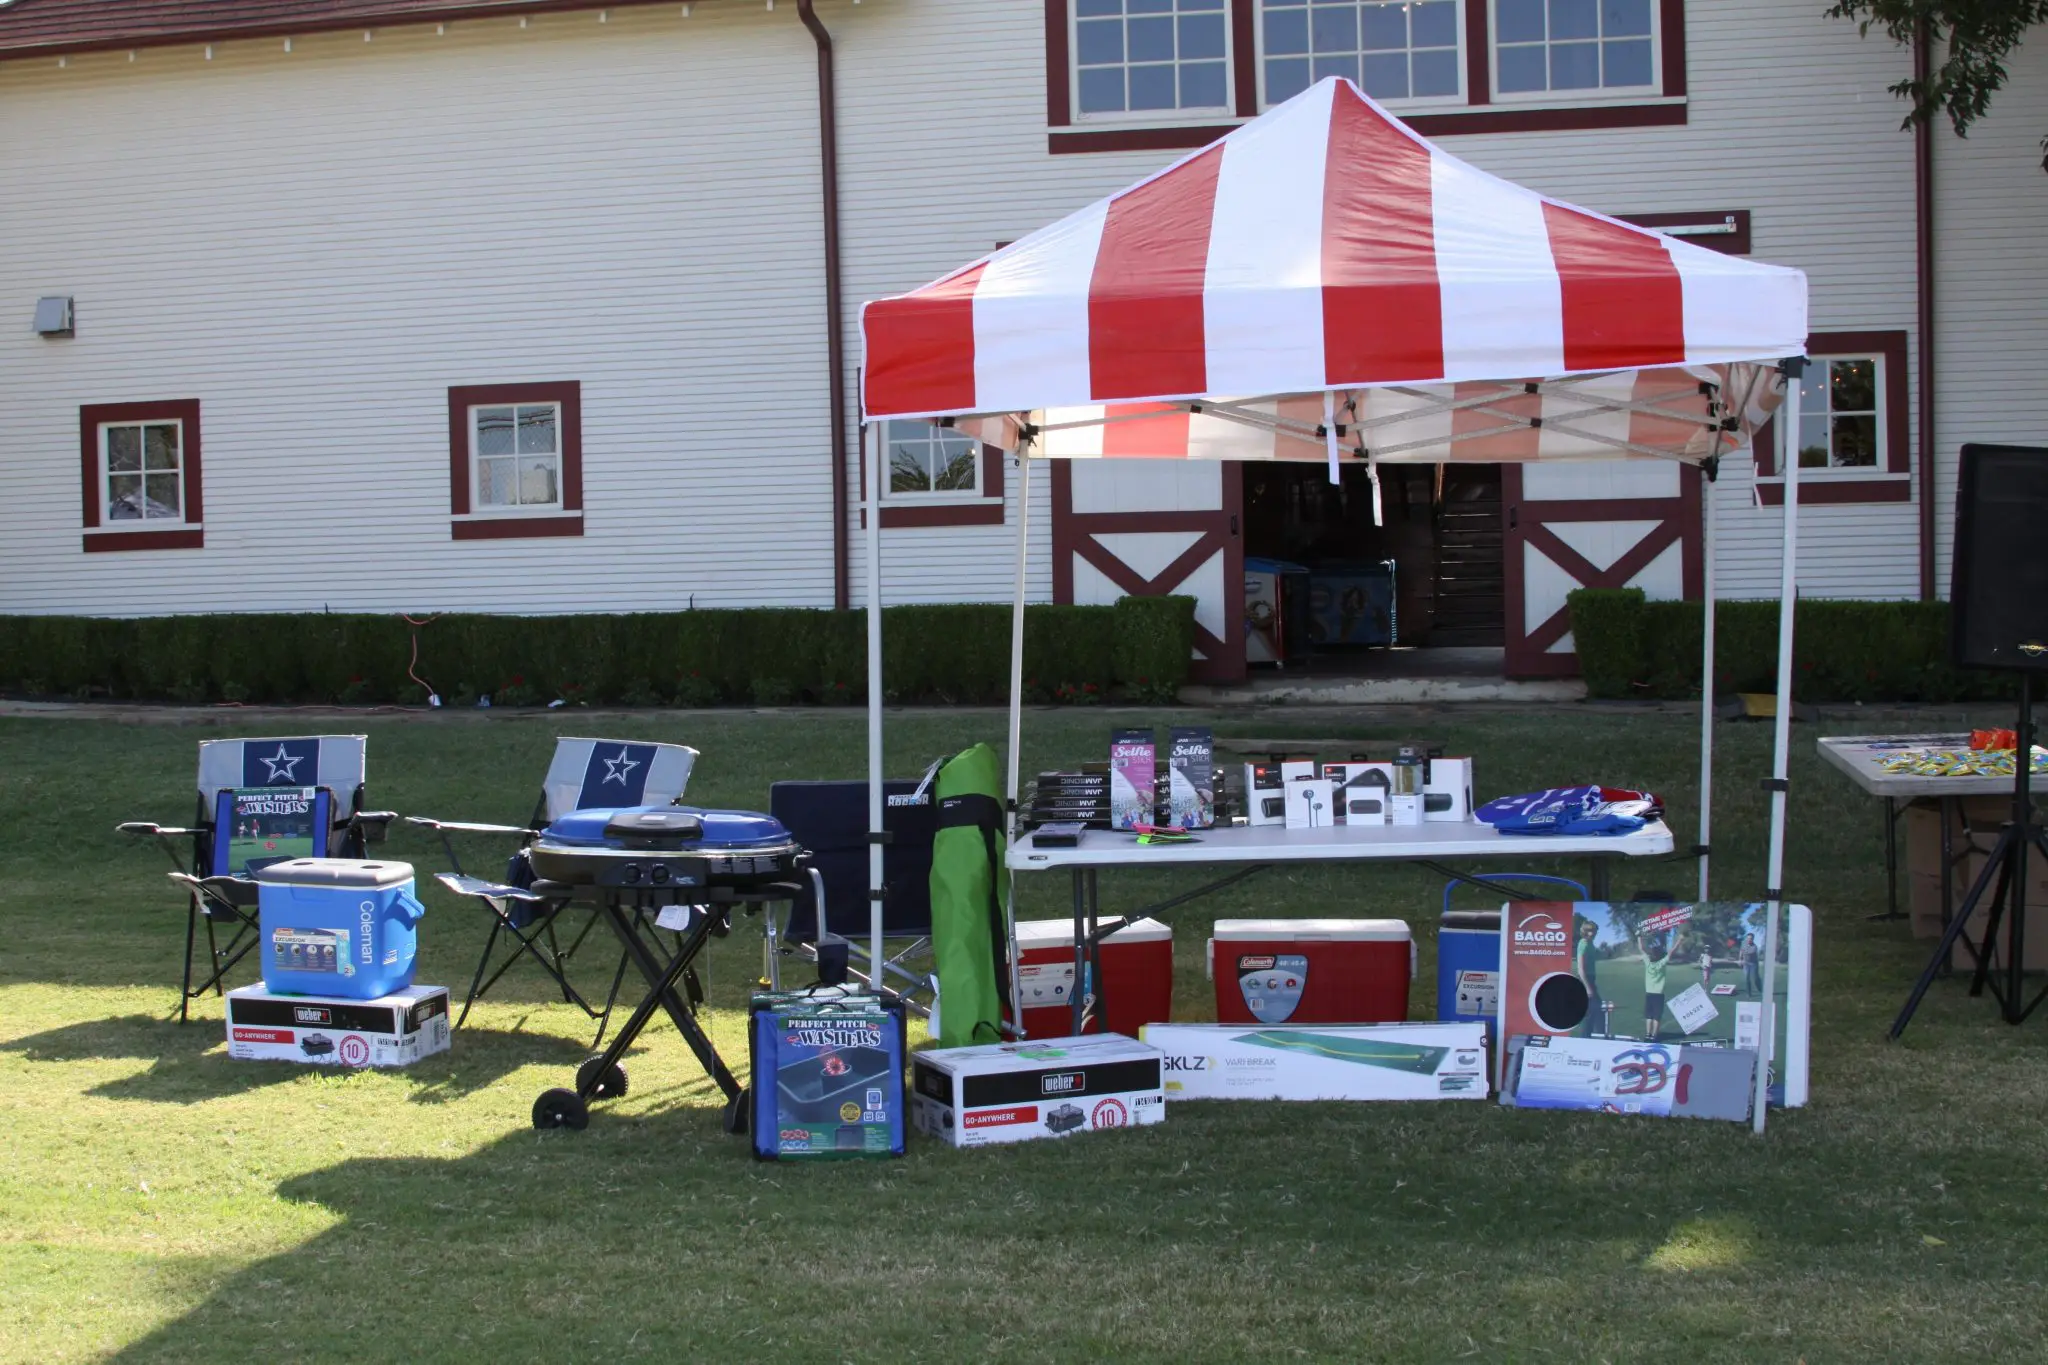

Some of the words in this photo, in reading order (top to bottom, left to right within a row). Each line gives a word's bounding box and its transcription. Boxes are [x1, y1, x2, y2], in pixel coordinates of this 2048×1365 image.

[1114, 746, 1151, 758] Selfie
[1173, 745, 1210, 757] Selfie
[238, 794, 272, 802] PERFECT
[274, 793, 298, 801] PITCH
[246, 800, 309, 814] WASHERS
[360, 900, 375, 964] Coleman
[1514, 931, 1567, 942] BAGGO
[297, 1008, 322, 1021] weber
[788, 1019, 833, 1028] PERFECT
[836, 1019, 867, 1028] PITCH
[235, 1031, 276, 1040] GO-ANYWHERE
[798, 1029, 881, 1047] WASHERS
[346, 1043, 359, 1059] 10
[1164, 1056, 1205, 1071] SKLZ
[1045, 1074, 1074, 1091] weber
[965, 1113, 1016, 1125] GO-ANYWHERE
[1099, 1108, 1115, 1126] 10
